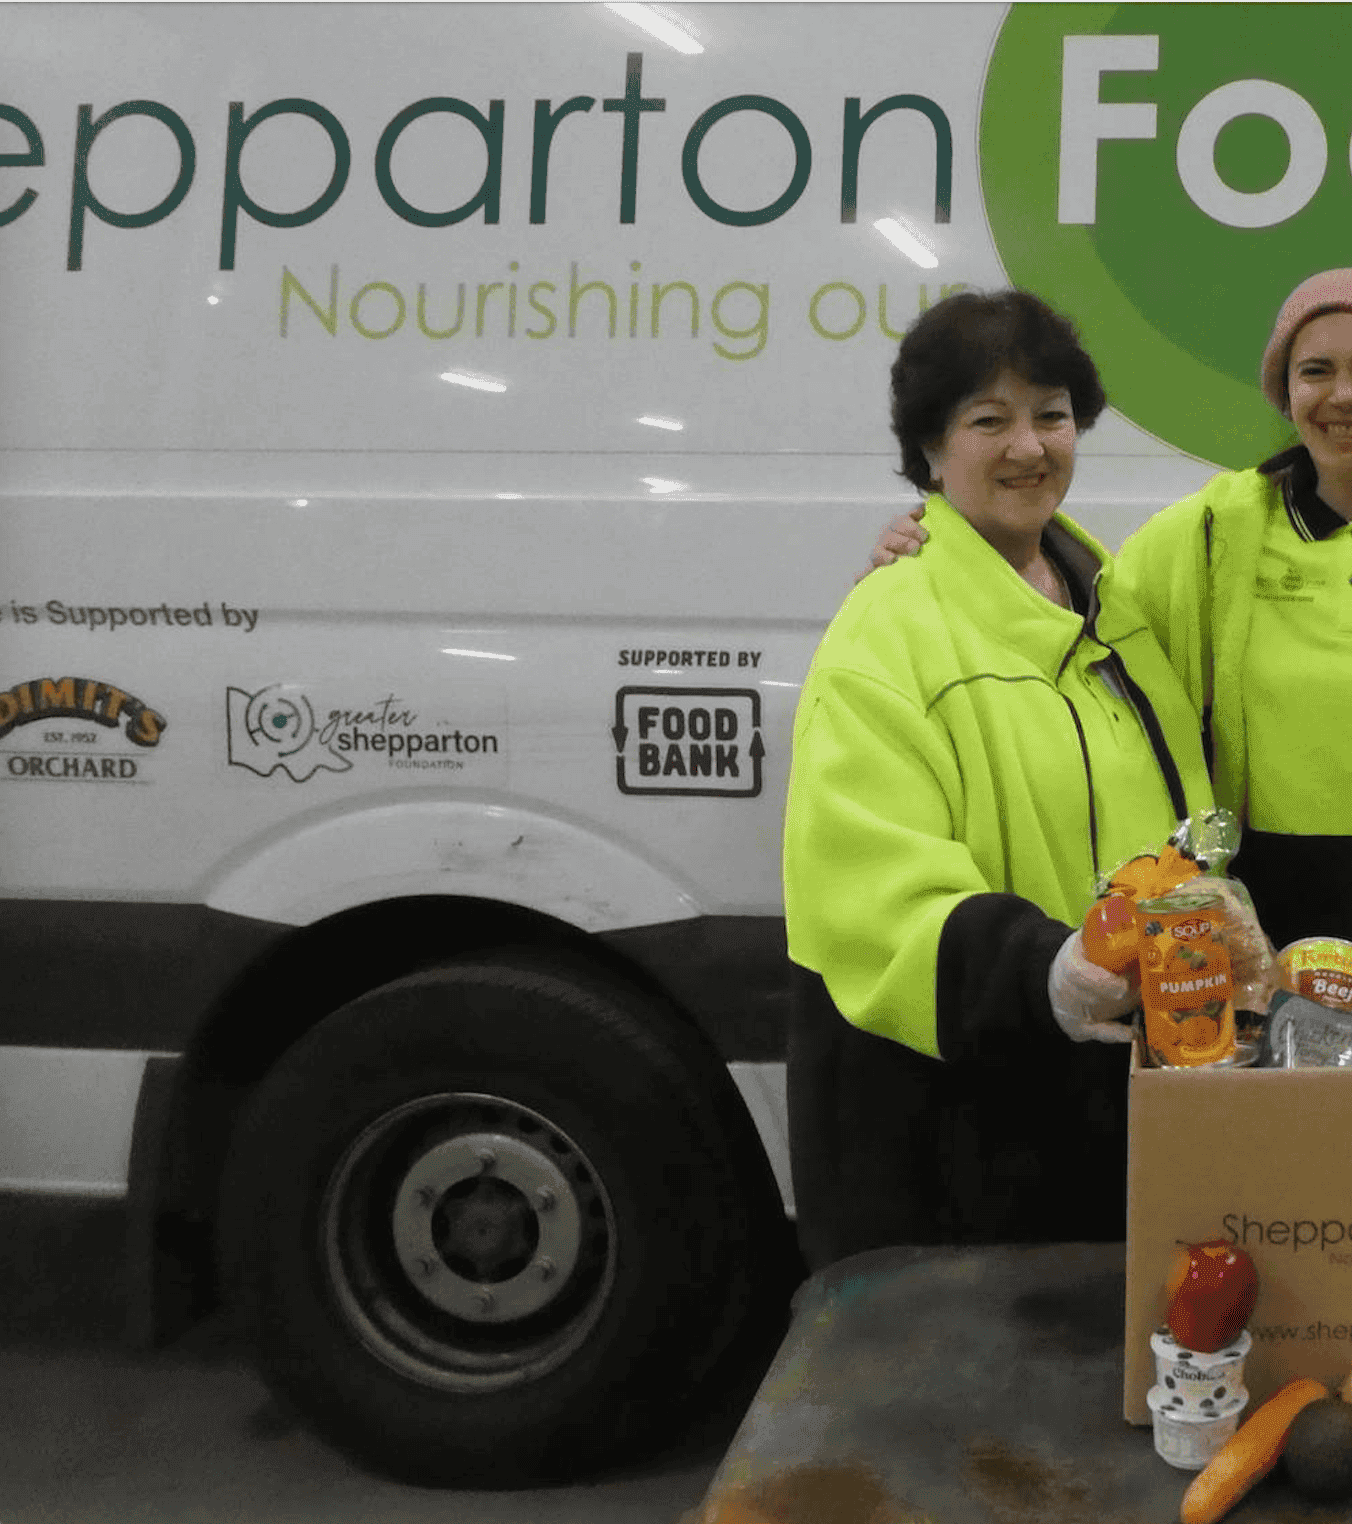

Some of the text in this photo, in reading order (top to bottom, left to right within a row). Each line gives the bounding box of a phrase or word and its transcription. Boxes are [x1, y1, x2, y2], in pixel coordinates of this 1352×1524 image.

[278, 259, 771, 362] Nourishing
[11, 600, 38, 625] is
[46, 600, 214, 632] Supported
[221, 601, 259, 633] by
[618, 650, 762, 668] SUPPORTED BY
[319, 693, 418, 746] greater
[638, 706, 739, 741] FOOD
[337, 727, 499, 758] shepparton
[7, 755, 138, 779] ORCHARD
[388, 759, 464, 770] FOUNDATION
[639, 743, 740, 778] BANK
[1160, 973, 1227, 994] PUMPKIN
